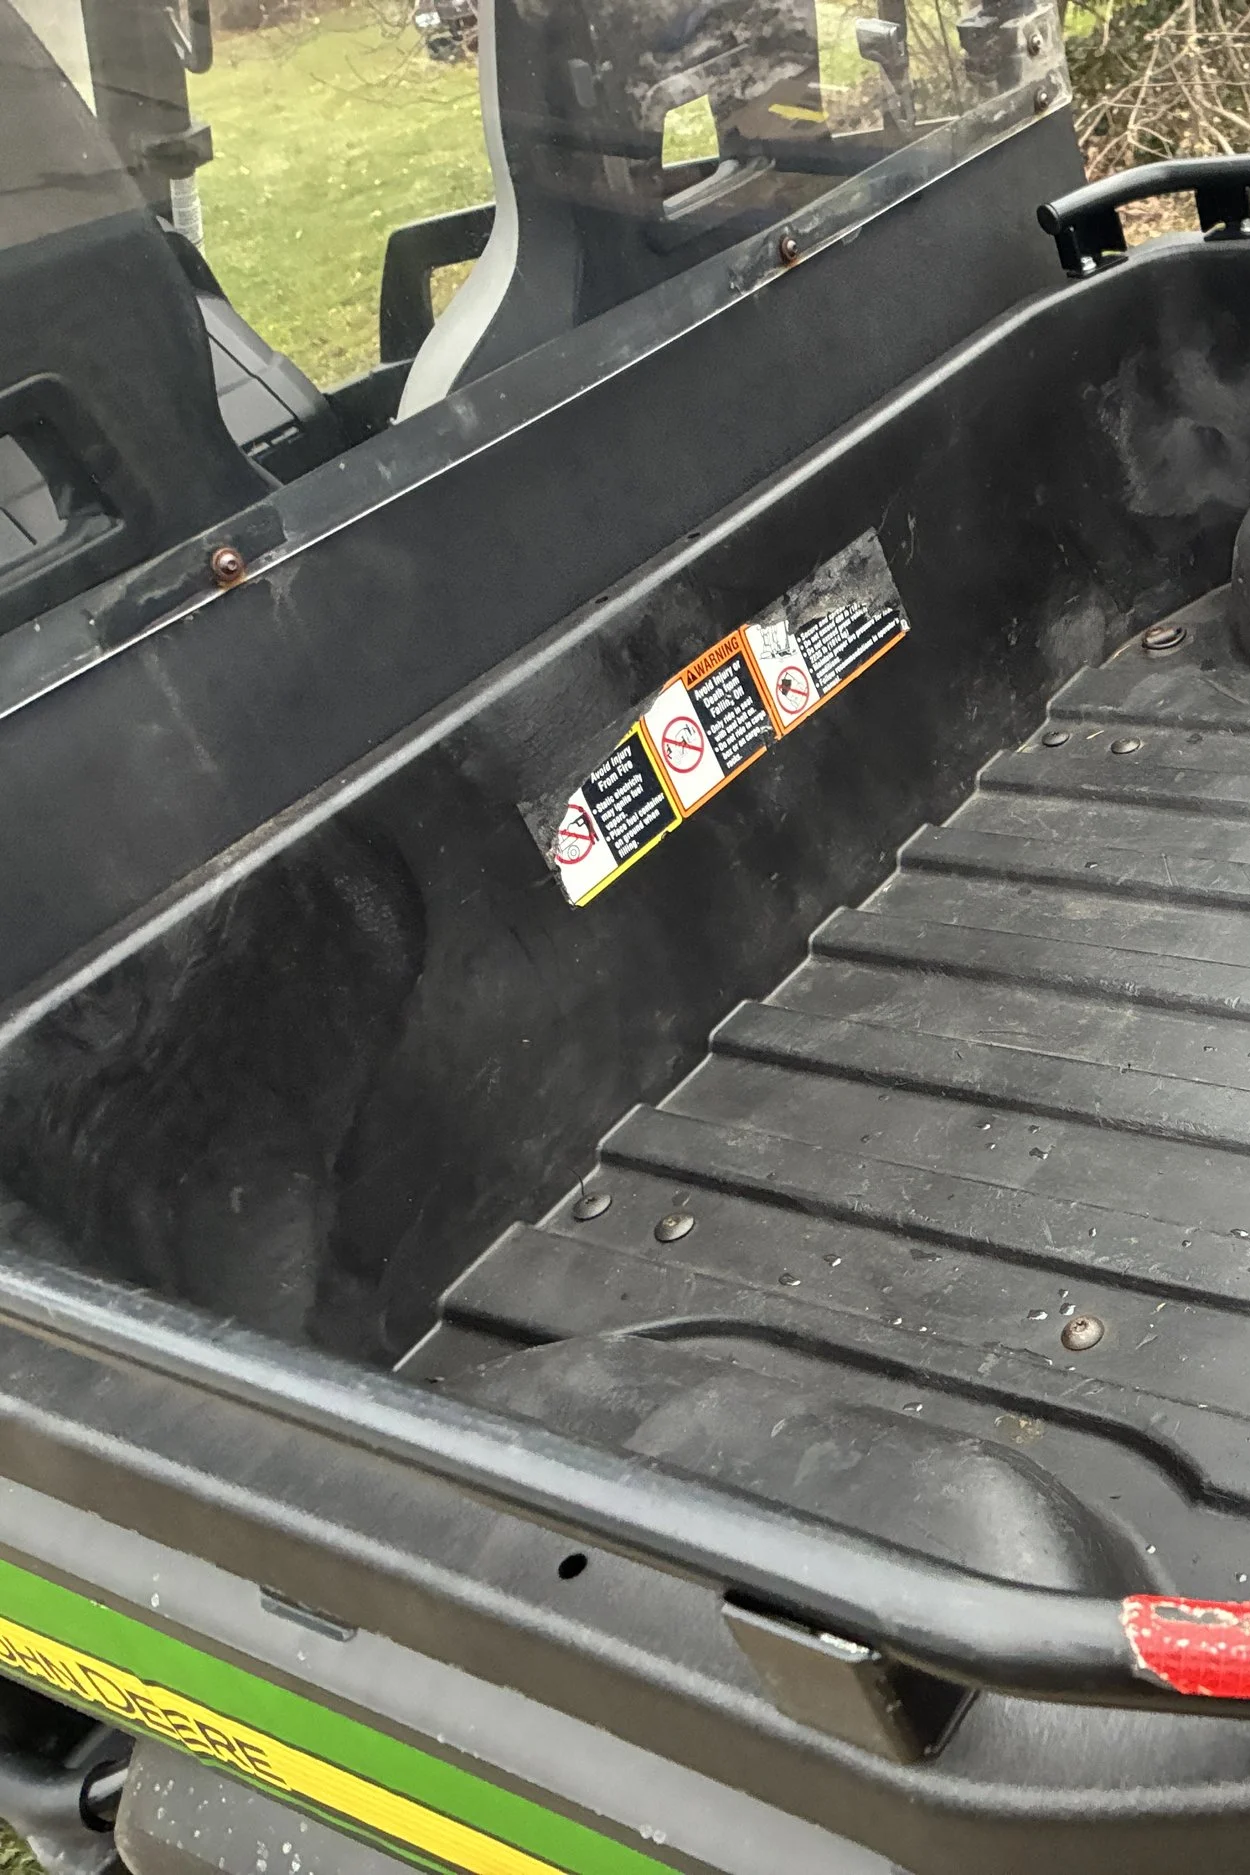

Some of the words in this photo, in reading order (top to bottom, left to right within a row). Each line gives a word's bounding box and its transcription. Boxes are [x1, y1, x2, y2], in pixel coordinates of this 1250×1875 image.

[694, 636, 739, 677] WARNING
[812, 652, 834, 671] Maintain
[833, 640, 848, 658] proper
[856, 619, 874, 638] pressure
[820, 671, 836, 686] Follow
[835, 638, 874, 674] recommendations
[694, 679, 714, 700] Avoid
[712, 666, 733, 686] Injury
[732, 660, 740, 671] or
[703, 688, 724, 708] Death
[723, 676, 740, 692] from
[733, 686, 745, 700] Off
[710, 720, 724, 734] Only
[724, 711, 736, 724] ride
[734, 706, 741, 716] in
[740, 696, 754, 710] seat
[714, 729, 726, 742] with
[726, 720, 738, 733] seat
[736, 711, 748, 725] belt
[747, 707, 757, 716] on.
[718, 741, 728, 752] Do
[726, 733, 736, 745] not
[735, 726, 746, 738] ride
[745, 721, 752, 730] in
[751, 710, 766, 725] cargo
[722, 748, 733, 760] box
[732, 743, 739, 752] or
[738, 738, 746, 747] on
[745, 726, 760, 742] cargo
[590, 761, 611, 783] Avoid
[611, 746, 632, 766] Injury
[598, 772, 618, 792] From
[617, 760, 633, 776] Fire
[596, 796, 614, 812] Static
[614, 773, 642, 800] electricity
[601, 808, 615, 822] may
[614, 794, 632, 812] ignite
[630, 783, 644, 798] fuel
[606, 812, 628, 830] vapors.
[610, 823, 627, 840] Place
[626, 812, 639, 826] fuel
[638, 792, 664, 818] container
[614, 838, 624, 849] on
[623, 820, 644, 843] ground
[643, 808, 660, 825] when
[618, 840, 640, 858] filling.
[76, 1661, 286, 1784] DEERE
